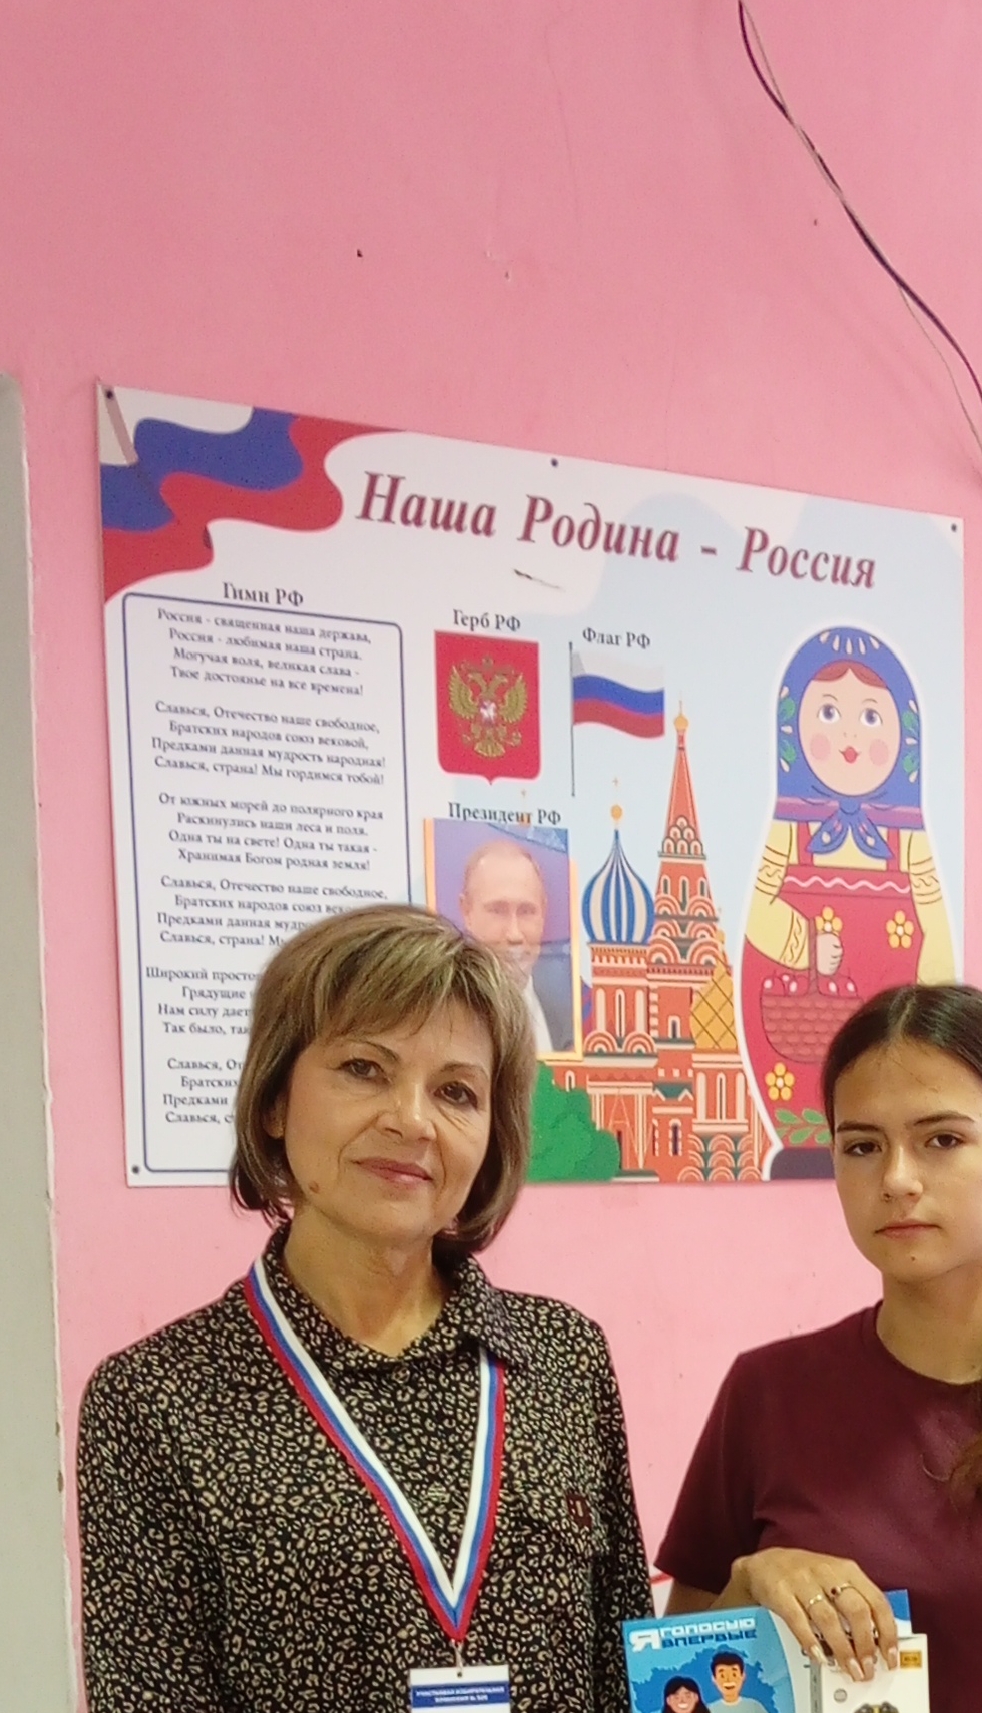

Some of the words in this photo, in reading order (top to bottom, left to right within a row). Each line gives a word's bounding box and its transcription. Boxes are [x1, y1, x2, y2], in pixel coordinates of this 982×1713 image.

[355, 471, 497, 537] Наша
[516, 494, 680, 563] Родина
[700, 545, 718, 556] -
[735, 526, 876, 589] Россия
[222, 582, 270, 603] Гимн
[276, 588, 304, 607] РФ
[157, 608, 202, 624] Россия
[214, 618, 281, 632] священная
[285, 626, 315, 636] наша
[319, 629, 371, 644] держава,
[452, 609, 491, 630] Герб
[494, 612, 521, 632] РФ
[169, 628, 214, 643] Россия
[226, 636, 281, 650] любимая
[285, 644, 315, 655] наша
[319, 648, 362, 660] страна.
[582, 626, 621, 649] Флаг
[625, 630, 651, 649] РФ
[173, 647, 228, 664] Могучая
[232, 657, 263, 669] воля,
[268, 661, 316, 673] великая
[319, 666, 351, 677] слава
[170, 666, 199, 679] Твое
[204, 673, 266, 686] достоянье
[270, 679, 284, 688] на
[288, 681, 306, 690] все
[311, 683, 363, 695] времена!
[155, 702, 210, 717] Славься,
[214, 707, 278, 723] Отечество
[281, 716, 311, 726] наше
[315, 718, 380, 733] свободное,
[169, 721, 227, 736] Братских
[231, 730, 282, 742] народов
[285, 734, 314, 744] союз
[318, 737, 368, 749] вековой,
[151, 737, 216, 753] Предками
[220, 746, 263, 757] данная
[267, 750, 323, 763] мудрость
[326, 755, 385, 767] народная!
[154, 756, 209, 772] Славься,
[213, 764, 257, 776] страна!
[261, 765, 282, 777] Мы
[286, 769, 343, 782] гордимся
[346, 773, 383, 784] тобой!
[158, 793, 175, 804] От
[180, 798, 226, 808] южных
[230, 801, 268, 814] морей
[272, 804, 286, 813] до
[290, 805, 354, 819] полярного
[357, 810, 383, 822] края
[447, 802, 533, 825] Президент
[537, 807, 562, 826] РФ
[177, 812, 256, 828] Раскинулись
[260, 821, 292, 830] наши
[296, 823, 321, 833] леса
[336, 826, 367, 835] поля.
[168, 830, 203, 843] Одна
[206, 836, 222, 844] ты
[226, 837, 241, 845] на
[244, 837, 279, 847] свете!
[284, 838, 315, 850] Одна
[319, 842, 335, 851] ты
[338, 844, 369, 853] такая
[178, 848, 241, 863] Хранимая
[245, 852, 282, 865] Богом
[286, 858, 328, 869] родная
[332, 861, 370, 870] земля!
[160, 876, 216, 891] Славься,
[220, 879, 284, 893] Отечество
[288, 886, 318, 895] наше
[322, 886, 387, 902] свободное,
[174, 894, 233, 910] Братских
[238, 901, 288, 913] народов
[292, 904, 321, 913] союз
[157, 913, 222, 927] Предками
[226, 919, 270, 928] данная
[159, 931, 216, 945] Славься,
[219, 935, 264, 948] страна!
[146, 967, 208, 982] Широкий
[212, 970, 258, 983] просто
[182, 986, 246, 1001] Грядущие
[158, 1003, 185, 1015] Нам
[189, 1008, 218, 1018] силу
[163, 1021, 185, 1033] Так
[189, 1023, 226, 1035] было,
[167, 1058, 222, 1070] Славься,
[163, 1094, 227, 1108] Предками
[165, 1111, 221, 1124] Славься,
[629, 1628, 662, 1653] Я
[661, 1617, 756, 1638] ГОЛОСУЮ
[662, 1629, 757, 1649] ВПЕРВЫЕ
